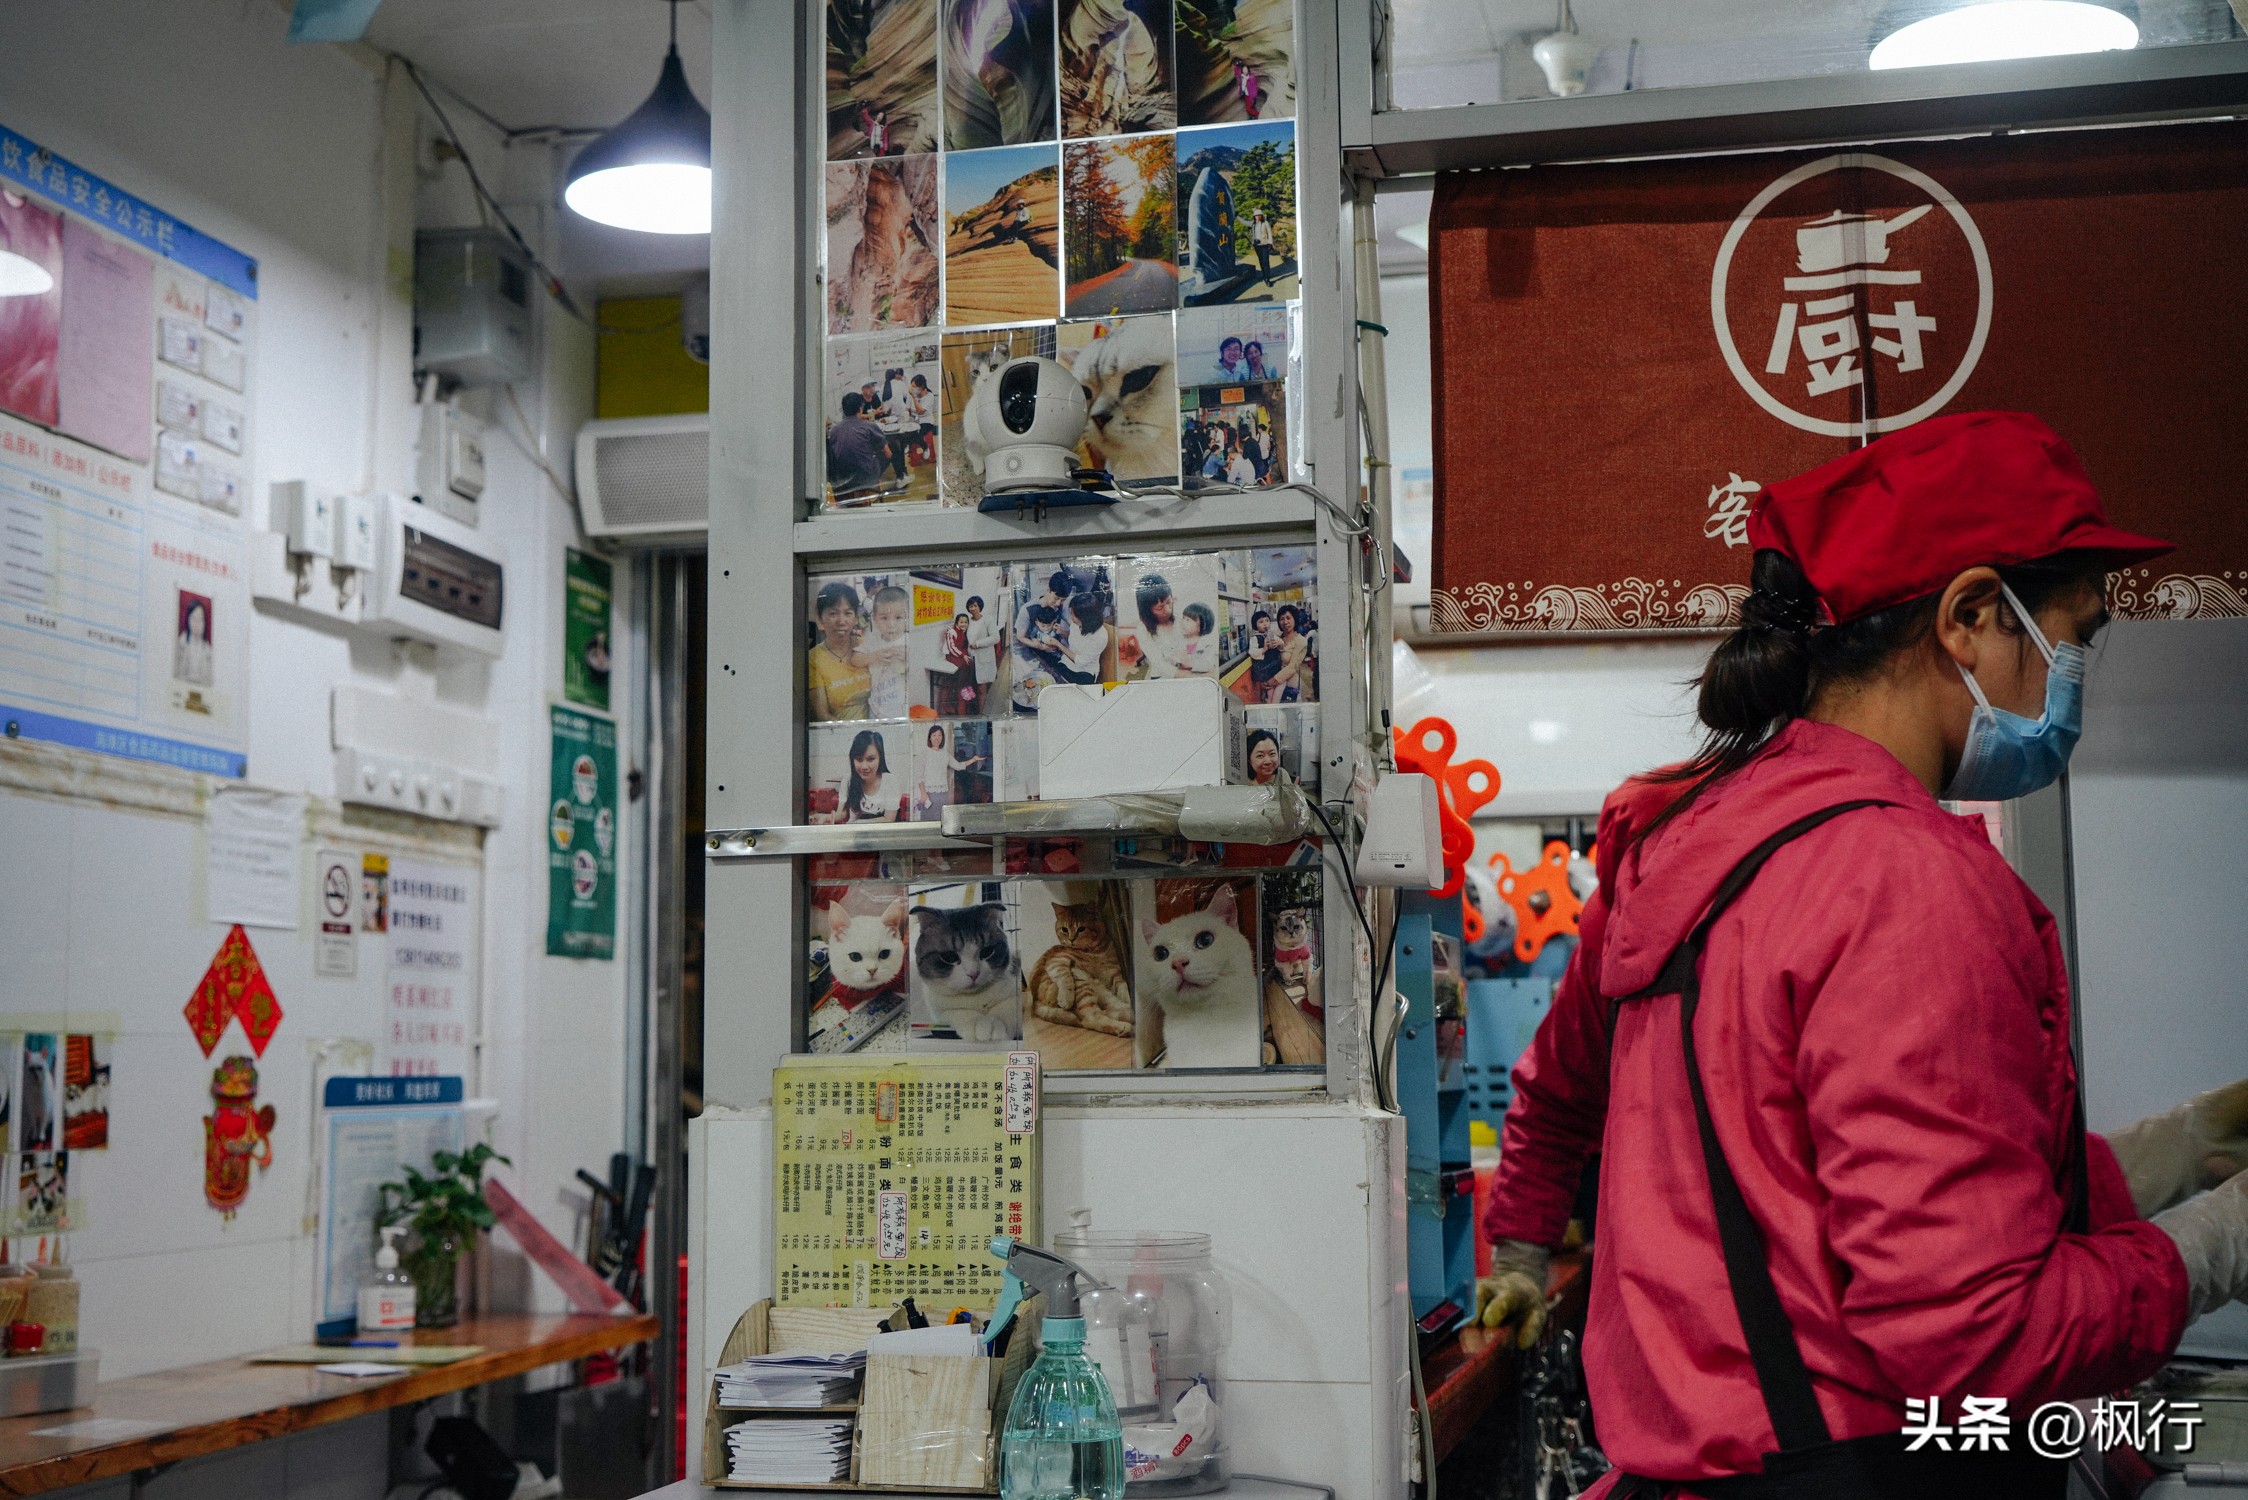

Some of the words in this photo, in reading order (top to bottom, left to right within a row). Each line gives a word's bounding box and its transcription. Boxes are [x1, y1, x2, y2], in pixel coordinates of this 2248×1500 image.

[784, 1082, 792, 1105] 纸巾
[795, 1082, 803, 1115] 干炒牛河
[832, 1082, 840, 1106] 炸酱面
[844, 1082, 852, 1114] 炸酱意粉
[820, 1139, 827, 1150] 9元
[832, 1139, 839, 1150] 9元
[857, 1139, 864, 1150] 8元
[869, 1139, 876, 1150] 8元
[880, 1135, 891, 1190] 粉面类
[1010, 1134, 1022, 1193] 主食类
[834, 1239, 840, 1249] 7元
[781, 1271, 789, 1301] 骨肉相连
[802, 1271, 809, 1290] 薯条
[812, 1271, 819, 1290] 虾饼
[833, 1272, 839, 1290] 鸡柳
[870, 1270, 880, 1294] 大鱿鱼
[895, 1271, 905, 1294] 多春鱼
[944, 1270, 953, 1294] 番薯片
[956, 1270, 966, 1294] 牛肉串
[968, 1270, 977, 1294] 鸡肉串
